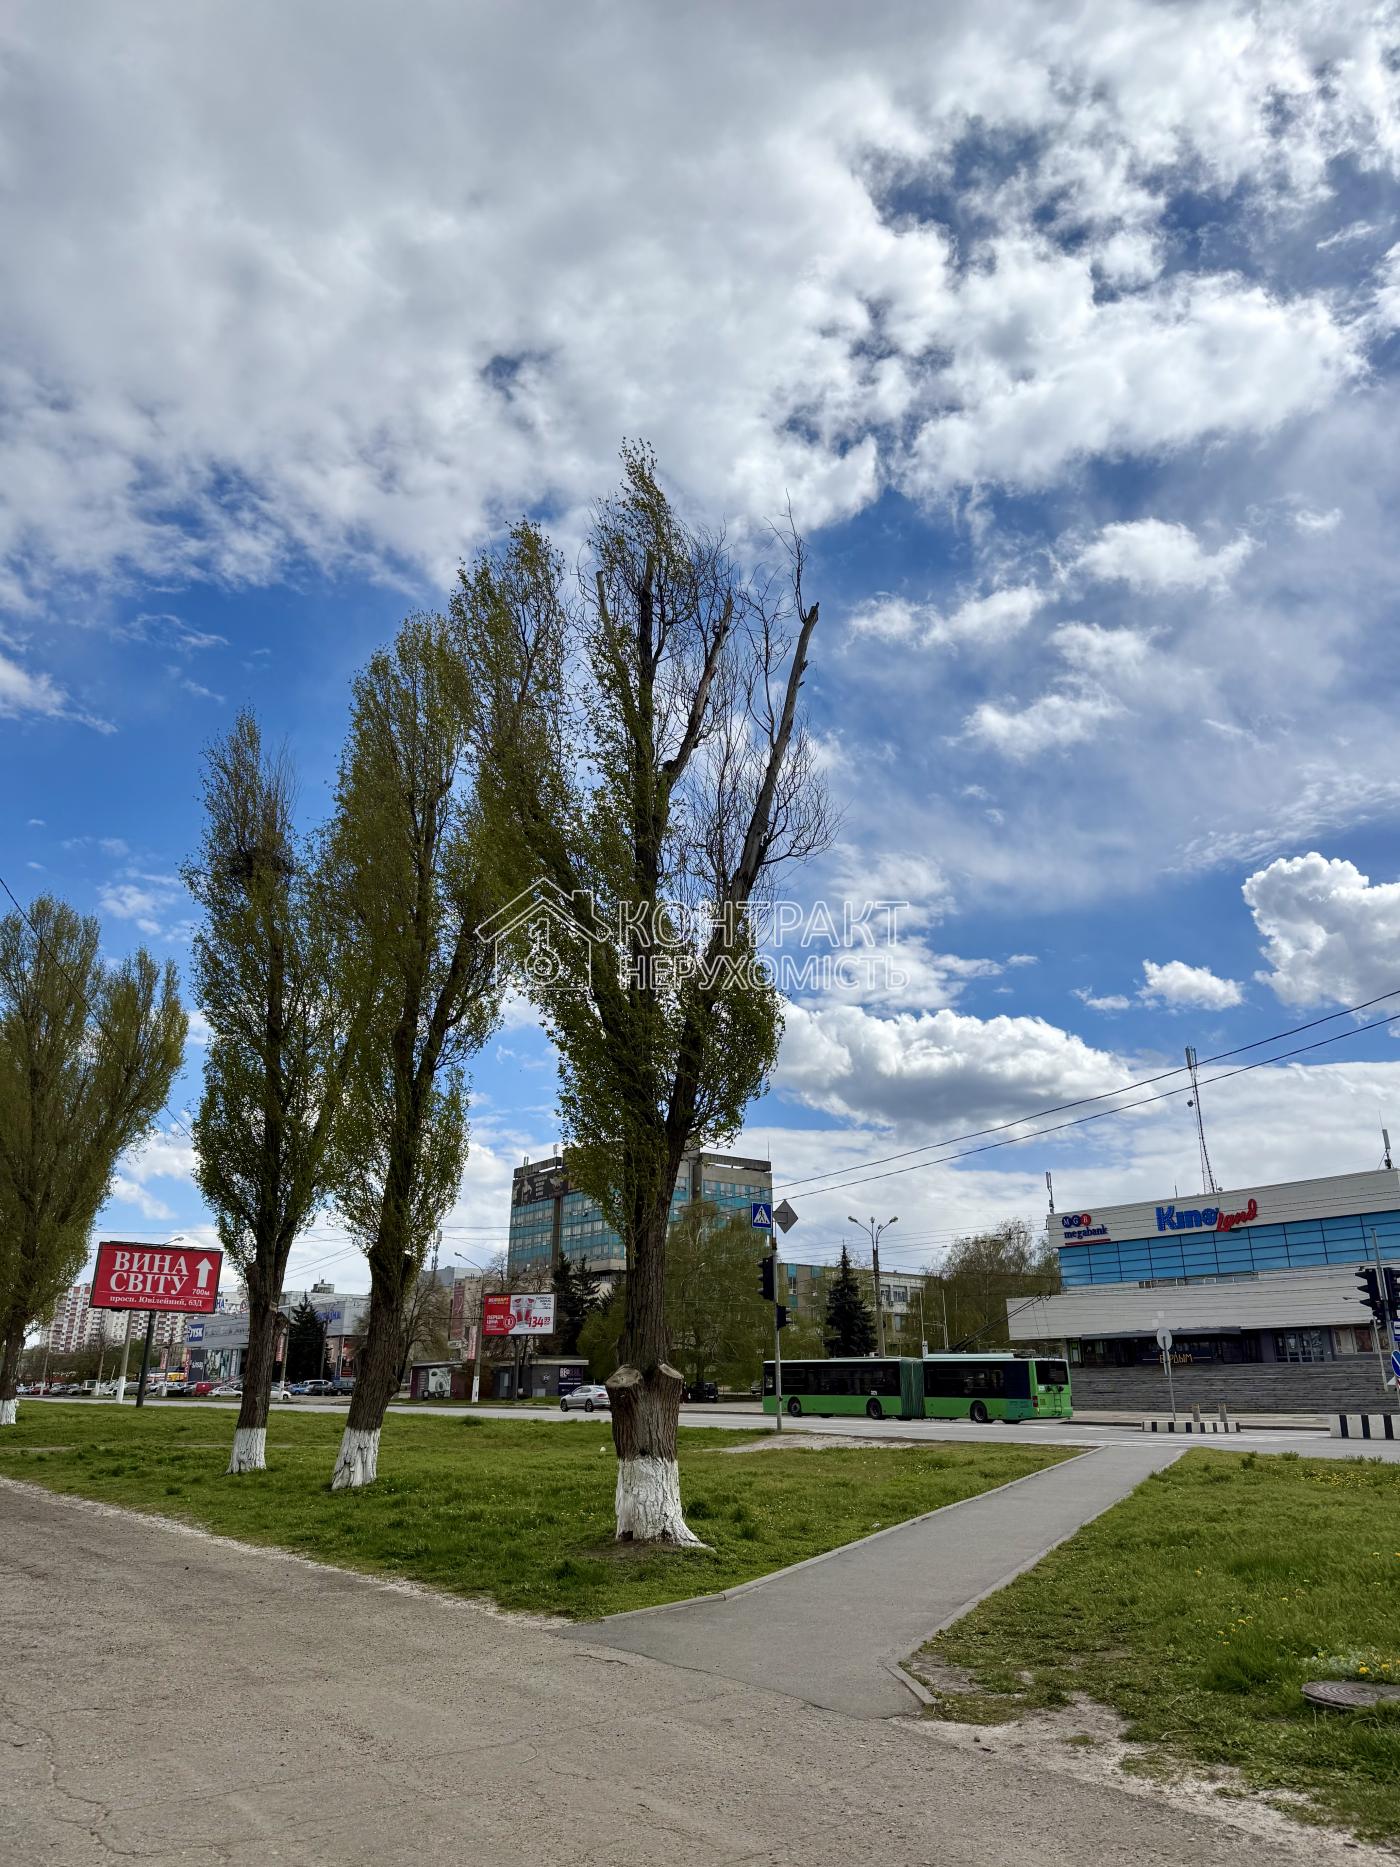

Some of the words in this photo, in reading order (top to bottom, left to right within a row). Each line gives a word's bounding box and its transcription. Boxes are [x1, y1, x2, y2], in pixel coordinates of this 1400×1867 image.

[1064, 1224, 1108, 1239] megabank
[112, 1251, 189, 1275] ВИНА
[110, 1271, 189, 1295] СВІТУ
[110, 1295, 136, 1303] просп.
[138, 1296, 186, 1306] Ювілейний,
